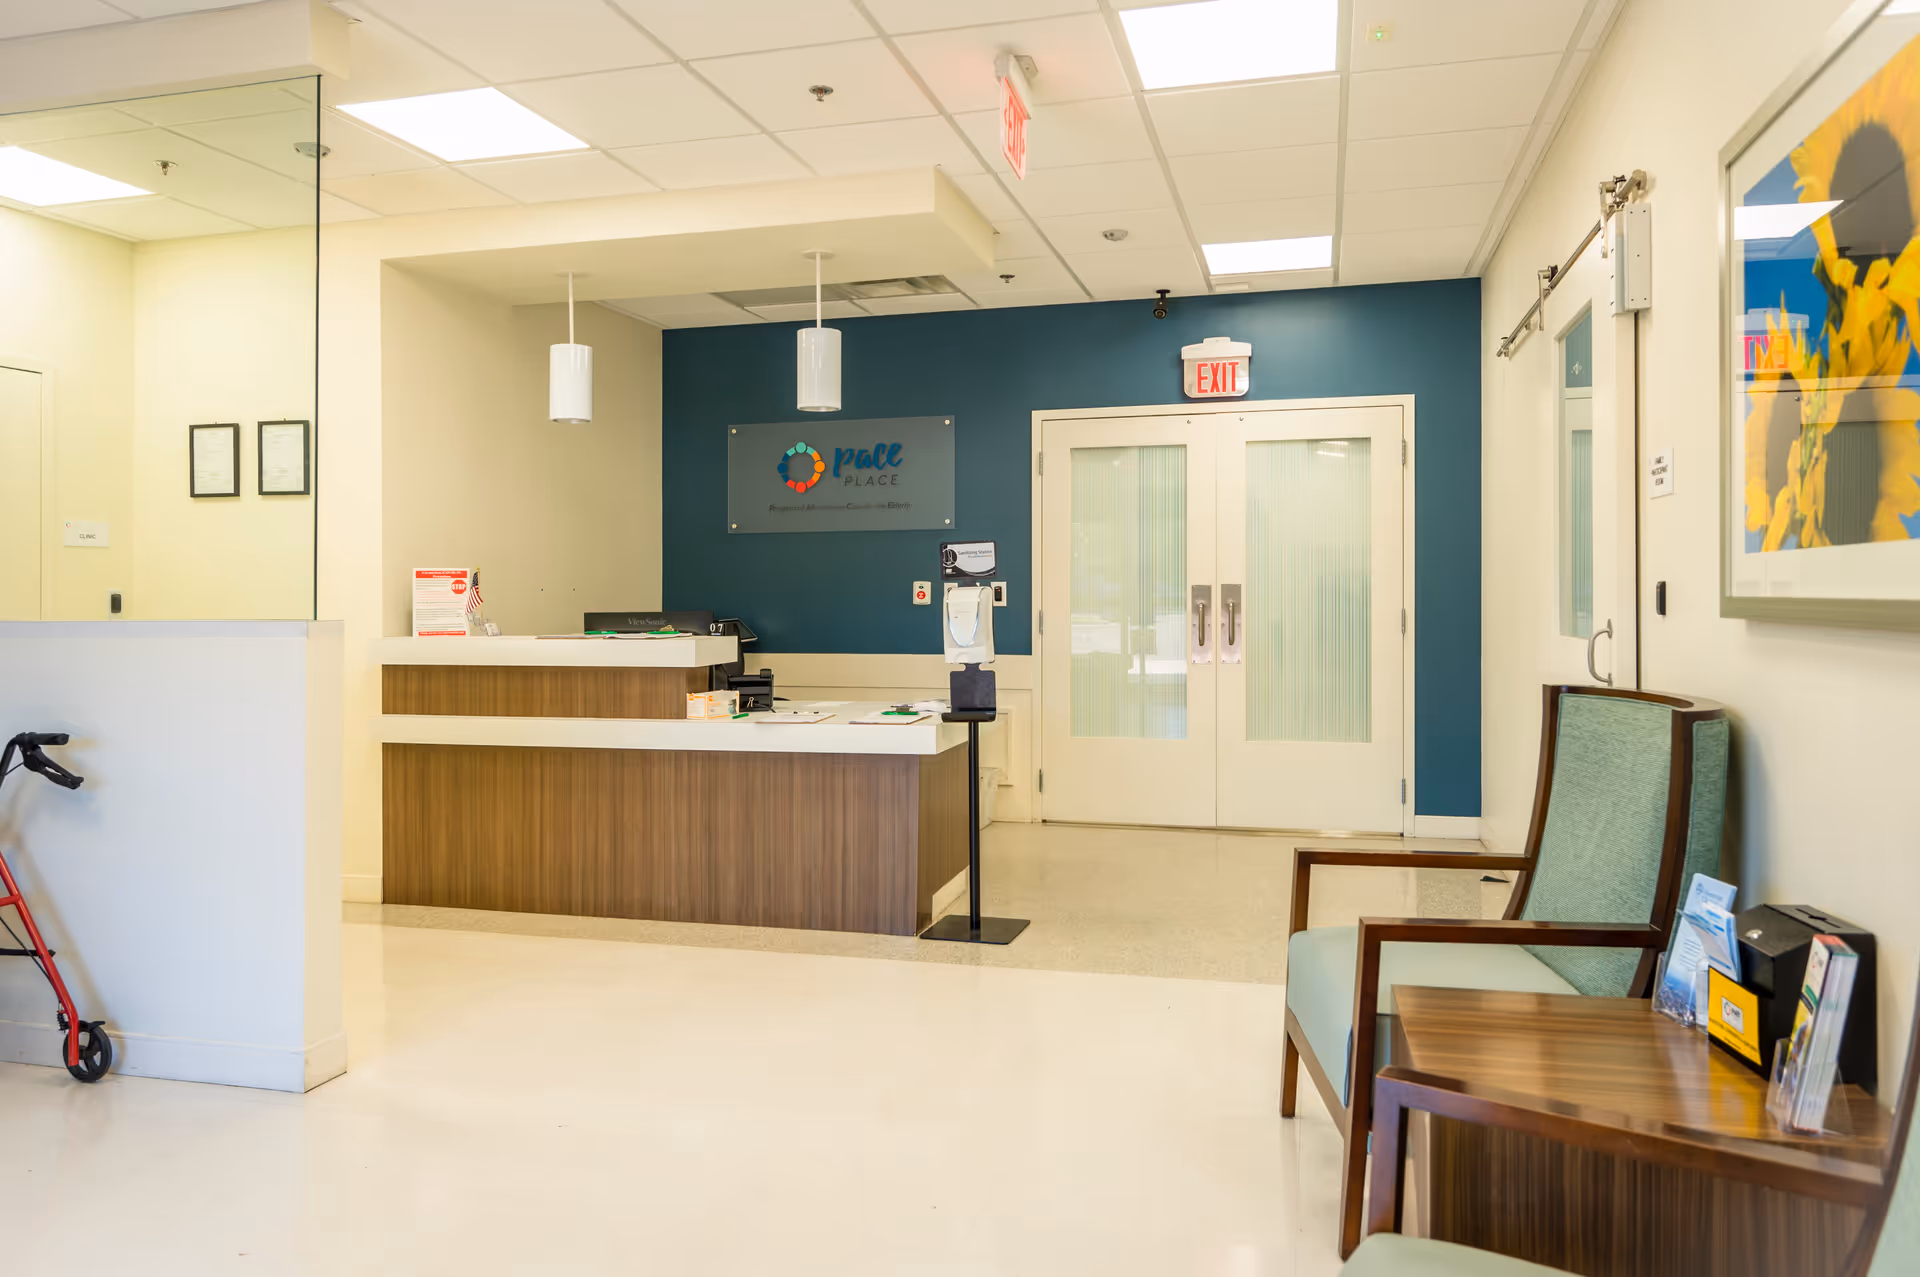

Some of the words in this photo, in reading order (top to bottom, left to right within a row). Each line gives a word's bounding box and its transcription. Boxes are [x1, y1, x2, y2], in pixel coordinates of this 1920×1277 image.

[1196, 361, 1239, 394] EXIT
[844, 474, 899, 487] PLACE
[451, 583, 466, 591] STOP
[627, 617, 667, 626] ViewSonic
